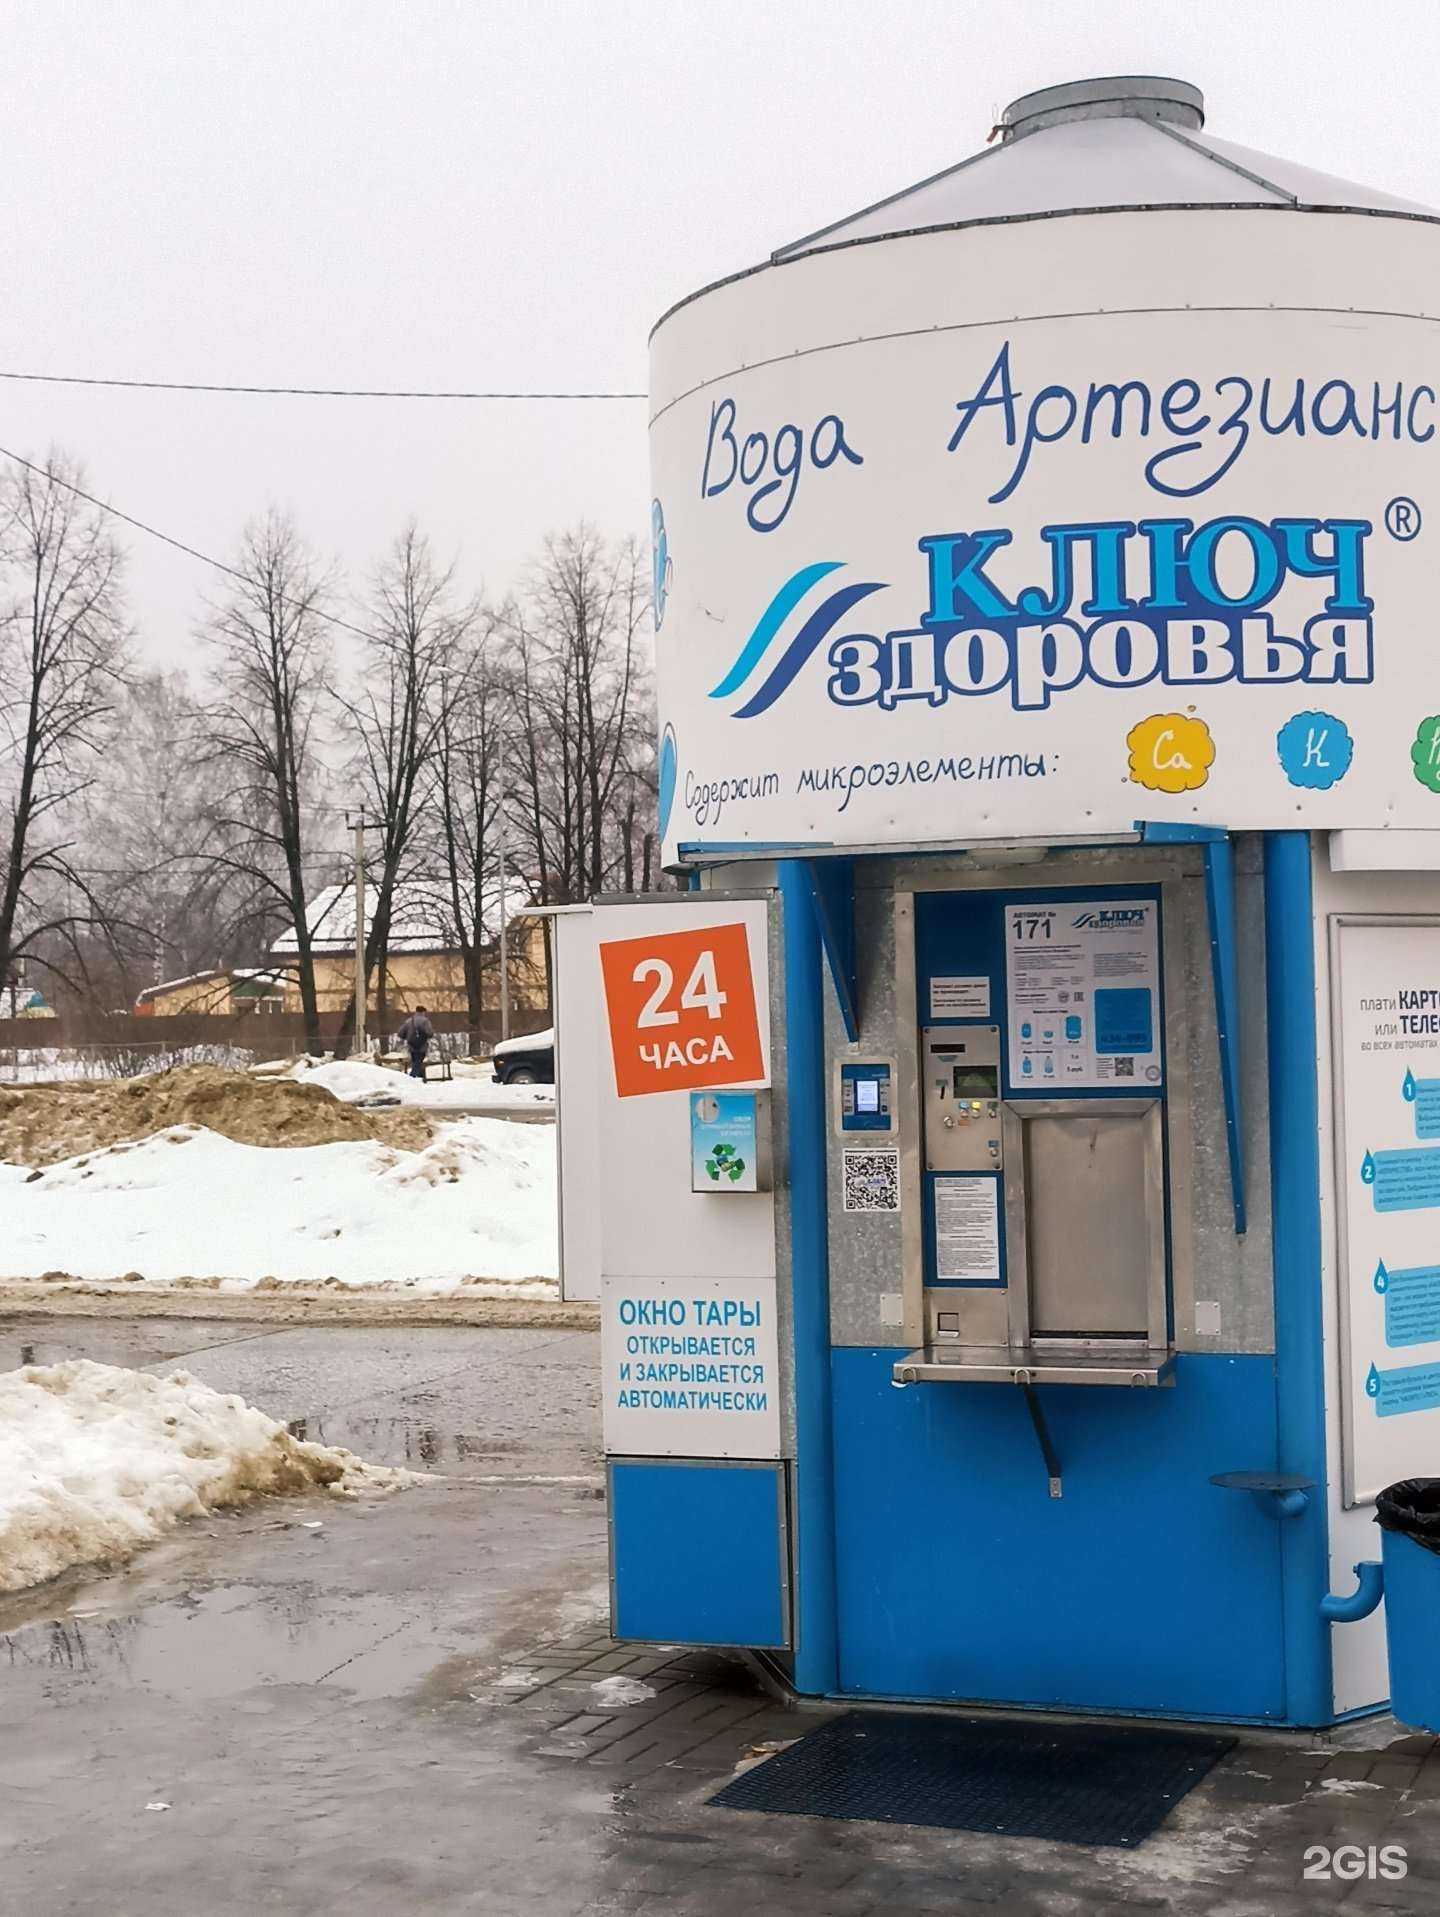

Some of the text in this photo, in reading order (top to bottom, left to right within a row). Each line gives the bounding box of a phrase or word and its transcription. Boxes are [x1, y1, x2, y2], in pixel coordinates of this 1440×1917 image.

[702, 341, 1436, 533] Вода Артезианс
[918, 516, 1374, 626] КЛЮЧ
[827, 608, 1374, 711] здоровья
[1153, 730, 1192, 770] Ca
[685, 753, 1060, 826] Содержит микроэлементы:
[1012, 918, 1051, 940] 171
[632, 951, 727, 1029] 24
[1360, 990, 1440, 1011] плати КАРТ
[1375, 1014, 1440, 1035] или ТЕЛЕ
[639, 1036, 734, 1070] ЧАСА
[1361, 1041, 1371, 1051] во
[1373, 1041, 1392, 1051] всех
[1406, 1083, 1412, 1096] 1
[1364, 1165, 1373, 1179] 2
[1377, 1275, 1385, 1288] 4
[619, 1299, 761, 1327] ОКНО ТАРЫ
[626, 1336, 756, 1357] ОТКРЫВАЕТСЯ
[619, 1362, 764, 1384] И ЗАКРЫВАЕТСЯ
[1370, 1378, 1377, 1392] 5
[617, 1389, 768, 1411] АВТОМАТИЧЕСКИ
